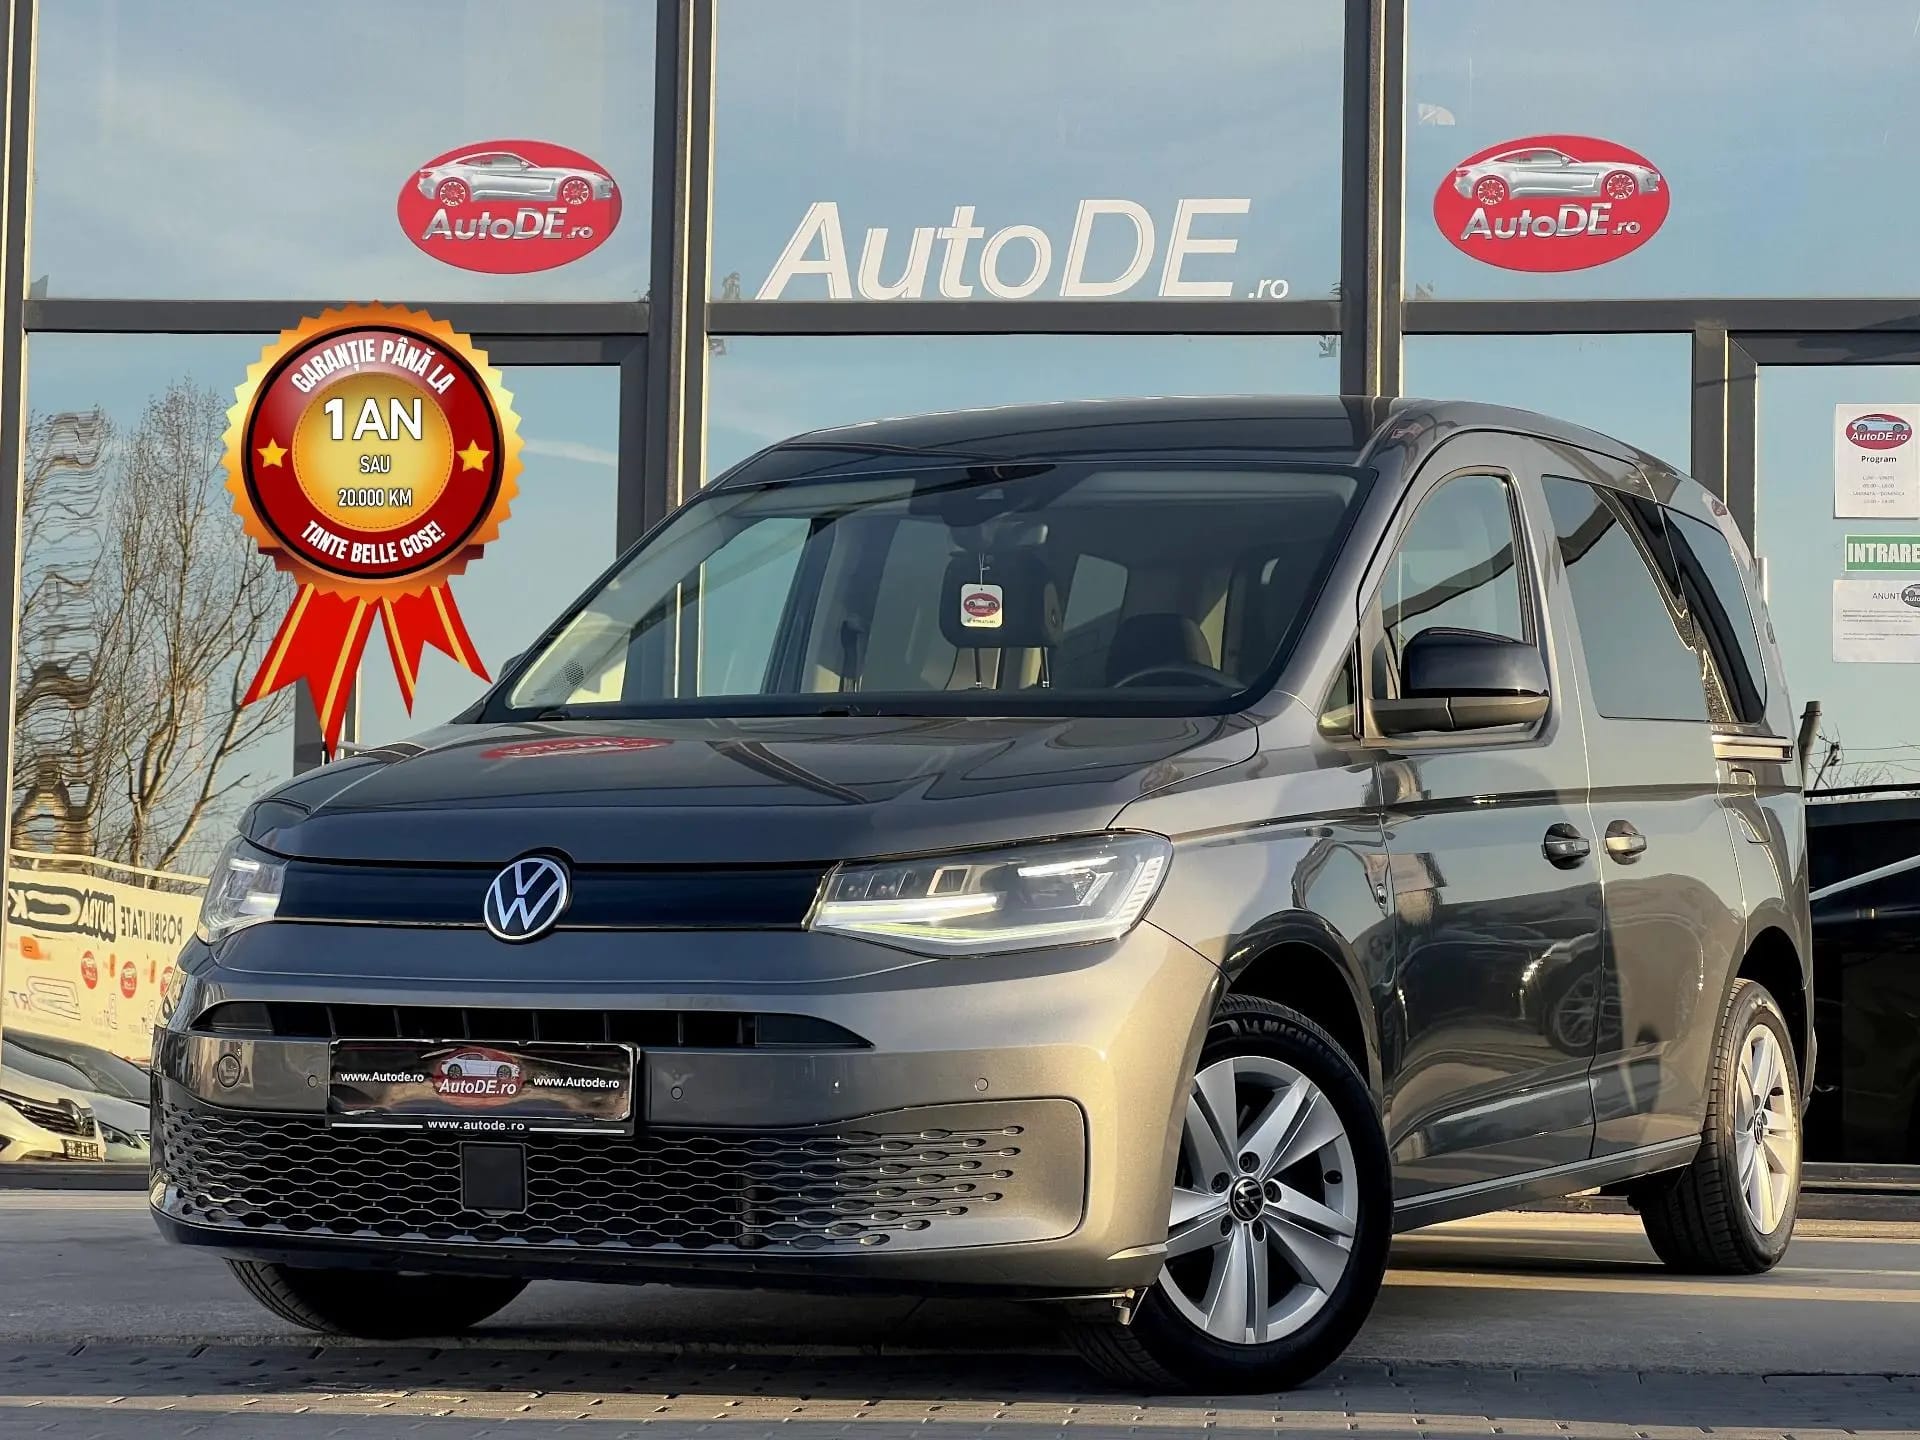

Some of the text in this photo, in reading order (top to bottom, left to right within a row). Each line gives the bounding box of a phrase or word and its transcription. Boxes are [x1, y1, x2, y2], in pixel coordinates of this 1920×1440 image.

[421, 207, 594, 240] AutoDE.ro
[1460, 202, 1641, 241] AutoDE.ro
[1851, 431, 1908, 441] AutoDE.ro
[1861, 455, 1897, 463] Program
[1848, 543, 1920, 563] INTRARE
[340, 1071, 424, 1083] www.Autode.ro
[534, 1076, 620, 1089] www.Autode.ro
[439, 1078, 517, 1095] AutoDE.ro
[427, 1119, 525, 1131] www.autode.ro
